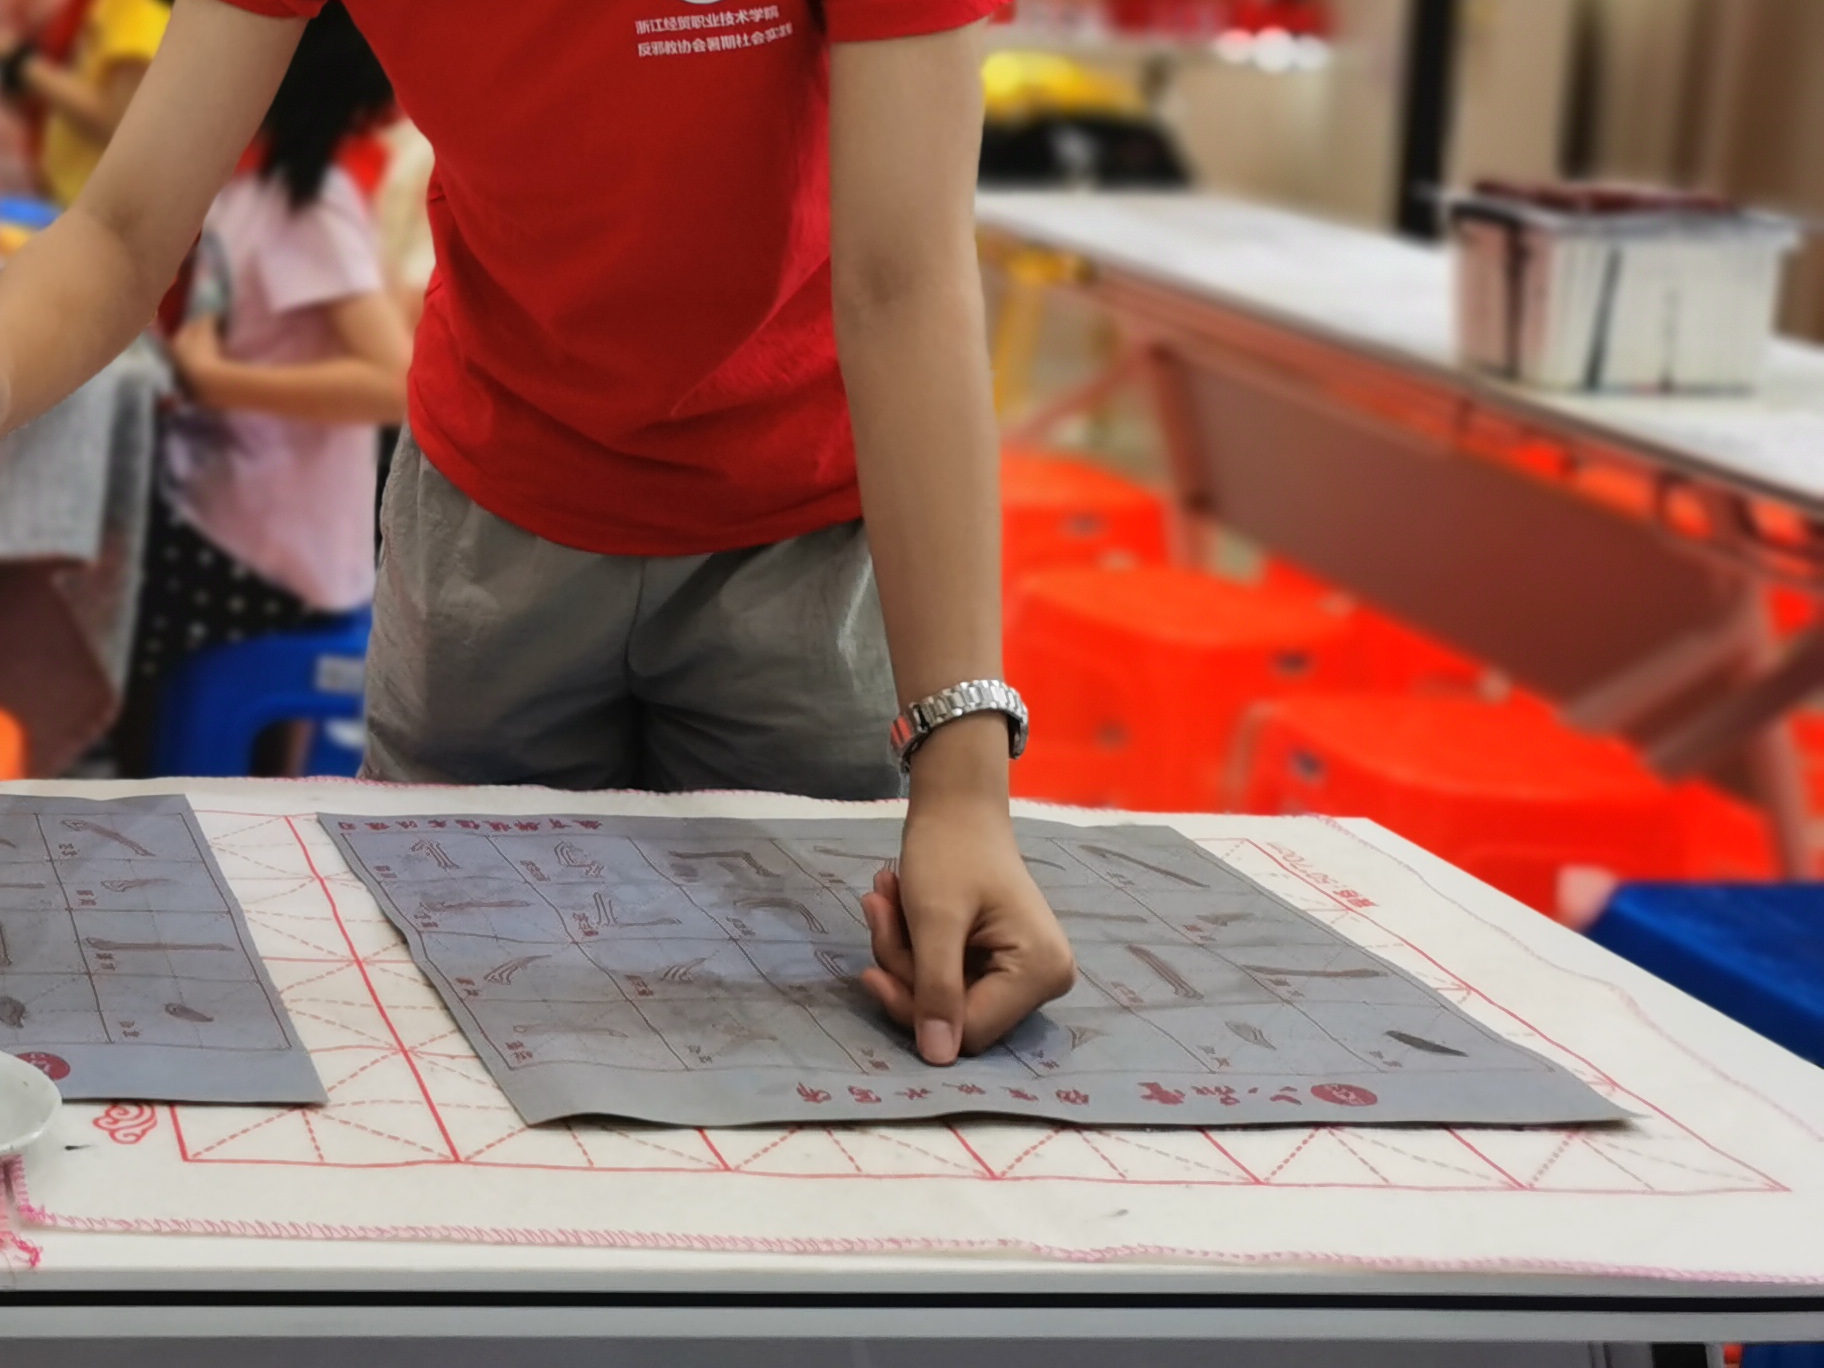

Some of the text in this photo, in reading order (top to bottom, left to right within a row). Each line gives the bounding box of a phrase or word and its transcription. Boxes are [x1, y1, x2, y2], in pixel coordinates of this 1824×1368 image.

[635, 5, 779, 34] 浙江经贸职业技术学院
